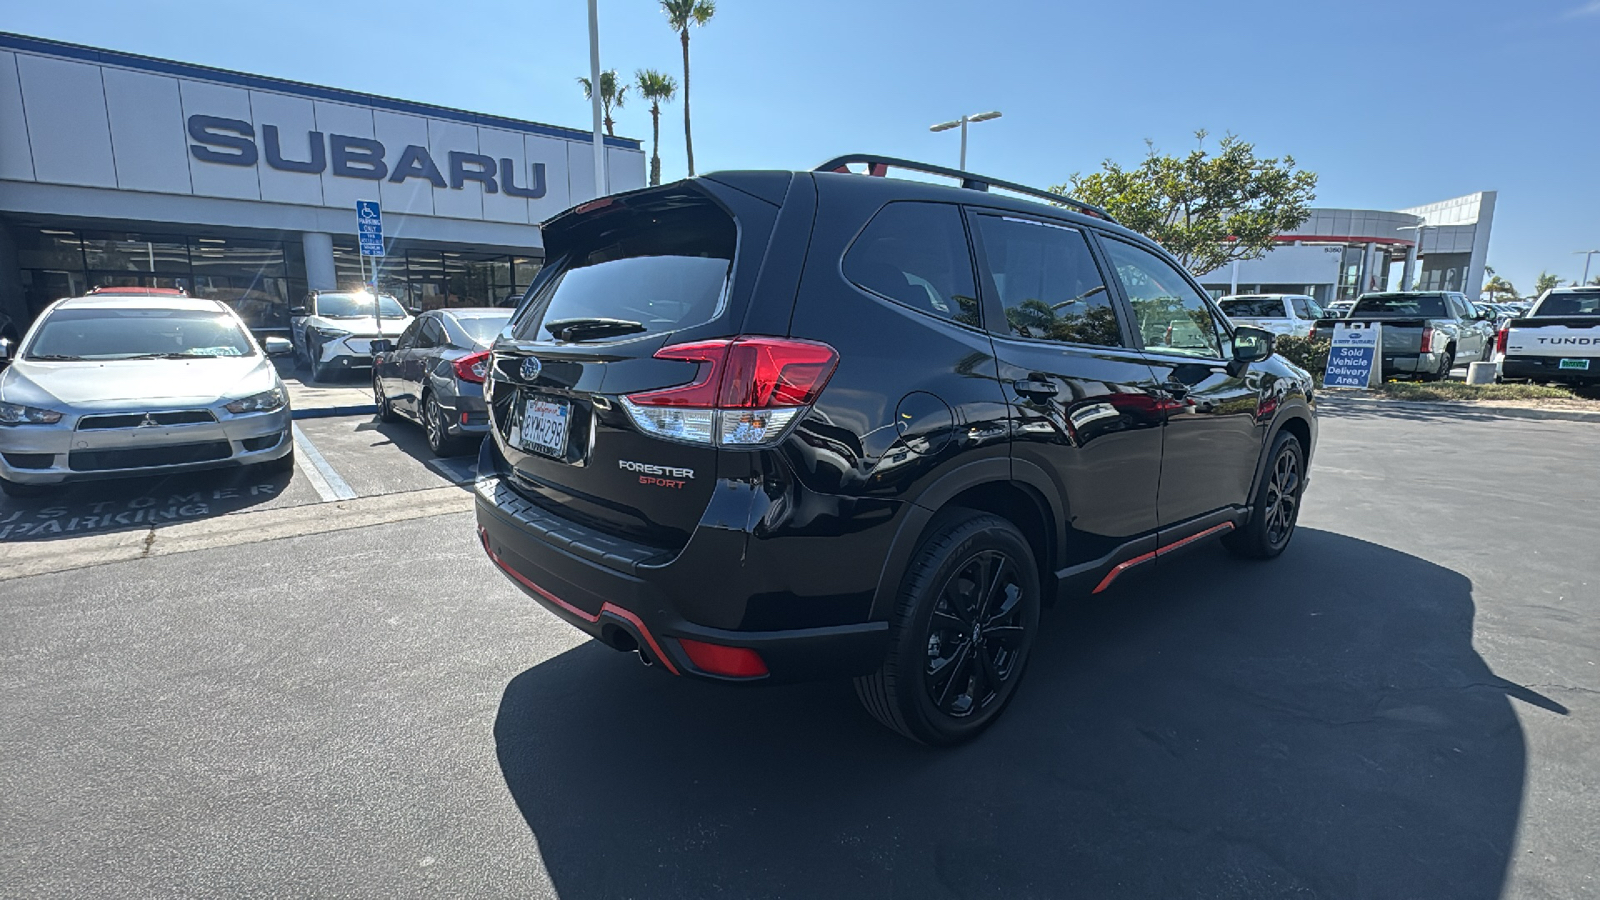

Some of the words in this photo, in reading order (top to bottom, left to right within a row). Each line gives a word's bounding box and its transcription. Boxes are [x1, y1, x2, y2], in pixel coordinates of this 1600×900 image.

[187, 113, 547, 199] SUBARU
[1340, 348, 1364, 357] Sold
[1333, 357, 1368, 366] Vehicle
[1328, 366, 1369, 378] Delivery
[1335, 376, 1359, 385] Area
[618, 459, 695, 479] FORESTER
[639, 475, 685, 489] SPORT
[0, 503, 209, 539] PARKING
